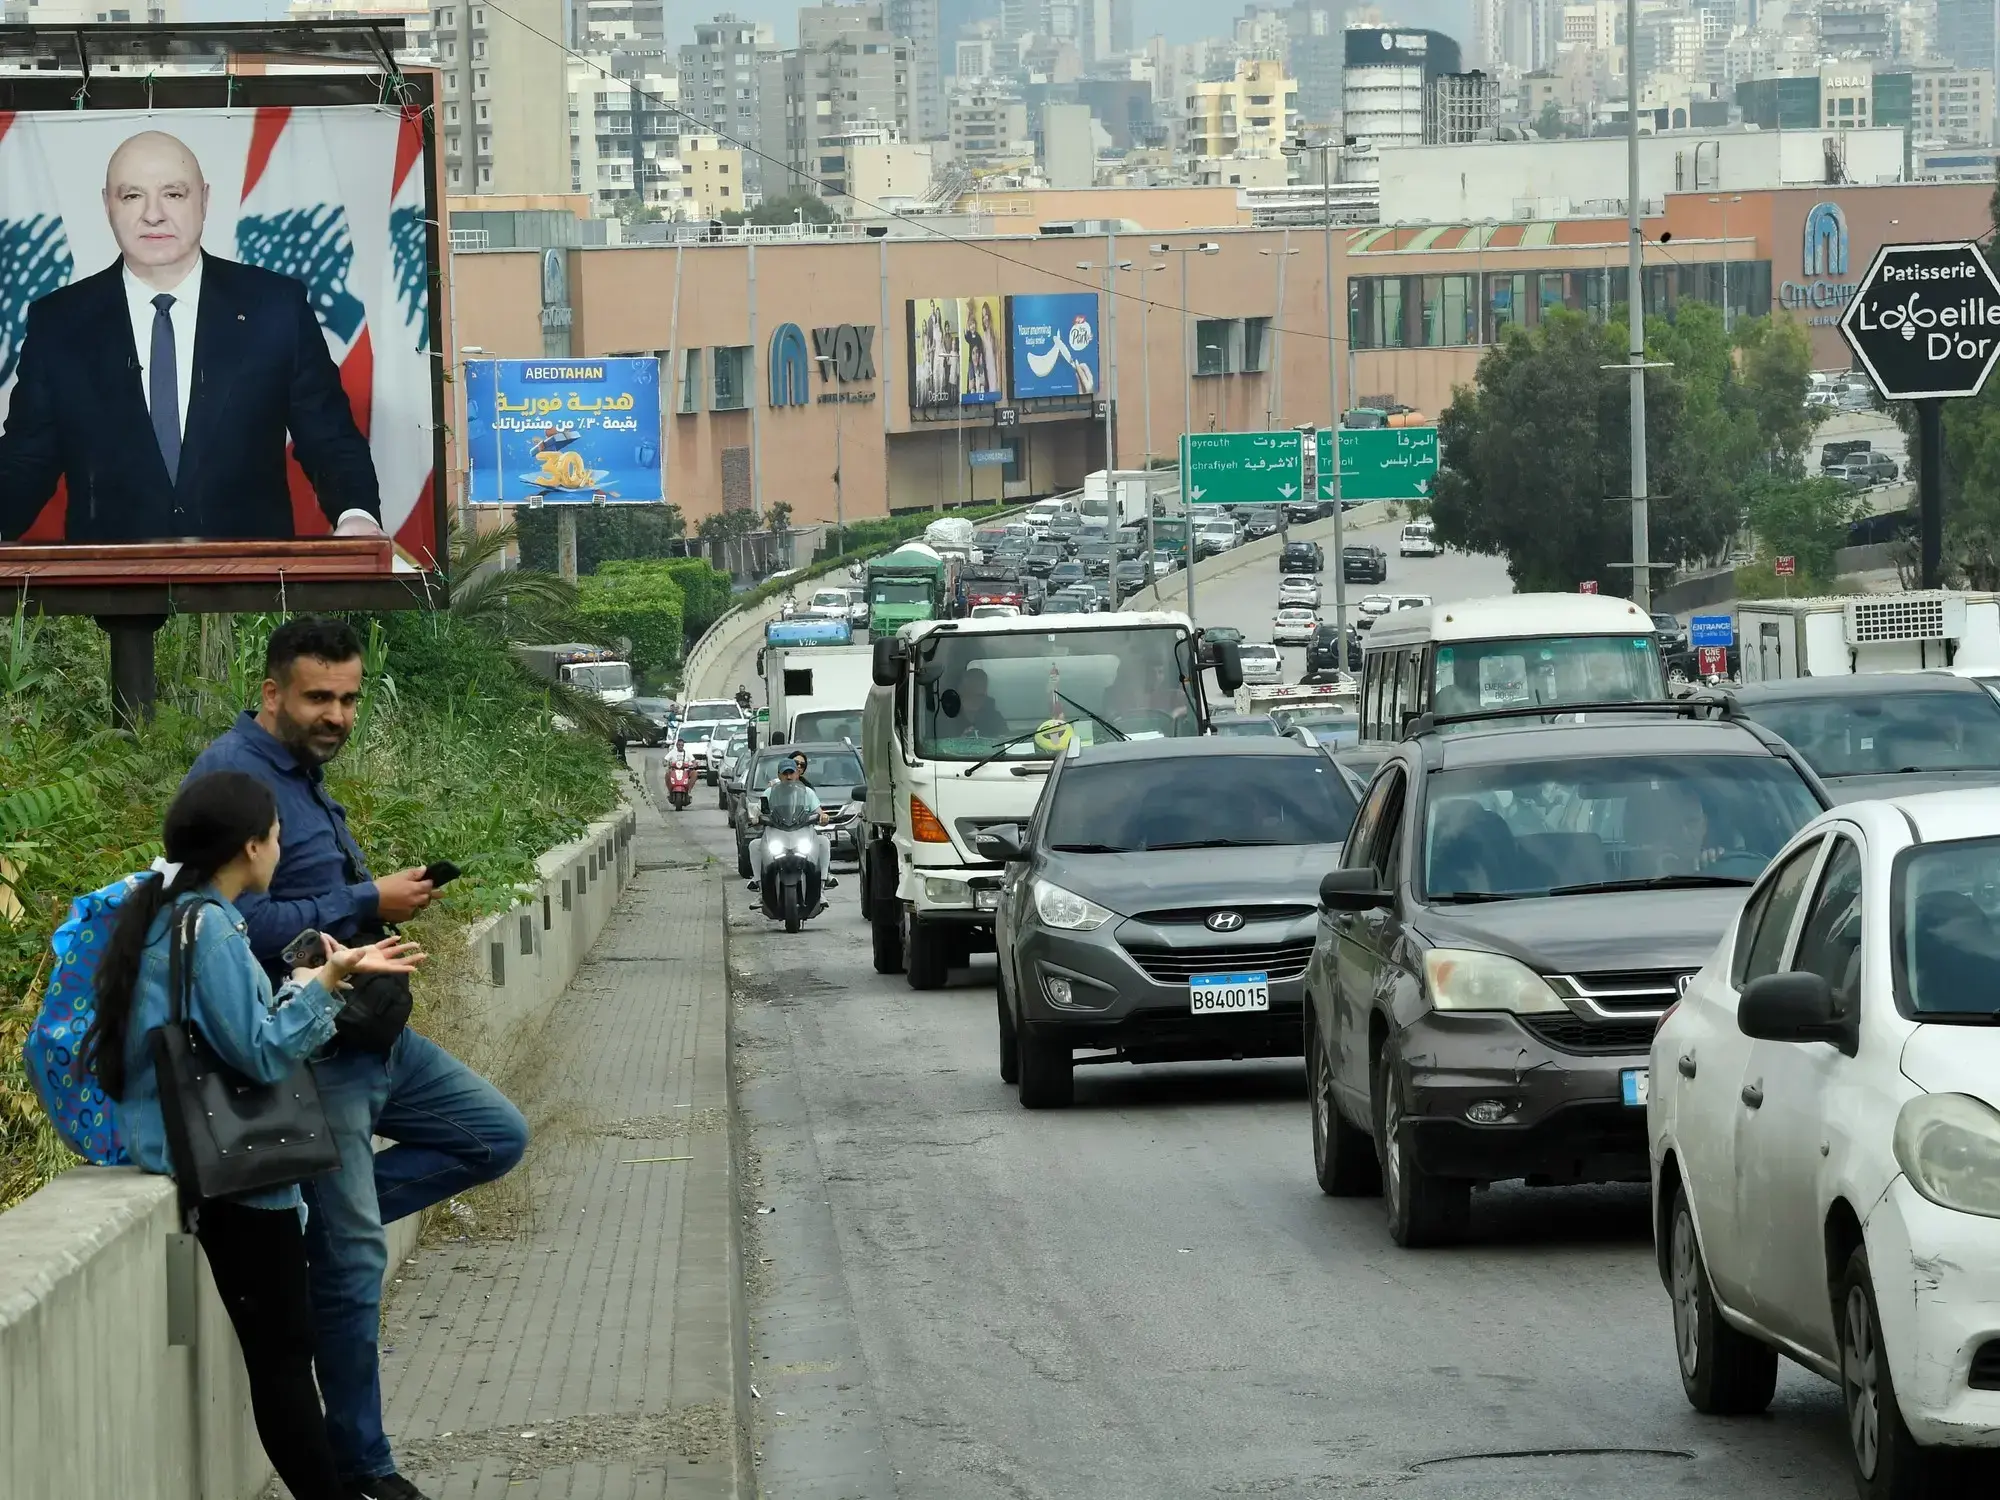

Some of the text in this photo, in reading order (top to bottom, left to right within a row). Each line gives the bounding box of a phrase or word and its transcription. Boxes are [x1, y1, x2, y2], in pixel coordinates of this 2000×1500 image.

[1827, 75, 1866, 88] ABRAJ
[1883, 261, 1976, 282] Patisserie
[812, 323, 876, 382] VOX
[1928, 332, 1991, 361] D'or
[525, 367, 602, 379] ABEDTAHAN
[496, 392, 634, 416] هدية فورية
[555, 417, 574, 432] من
[602, 416, 637, 432] بقيمة
[1191, 438, 1229, 449] eyrouth
[1253, 437, 1298, 448] بيروت
[1320, 438, 1332, 446] Le
[1396, 430, 1434, 449] المرفأ
[1190, 460, 1238, 471] chrafiyeh
[1380, 453, 1434, 468] طرابلس
[1693, 623, 1730, 631] ENTRANCE
[1705, 648, 1720, 656] ONE
[1193, 988, 1266, 1009] B840015
